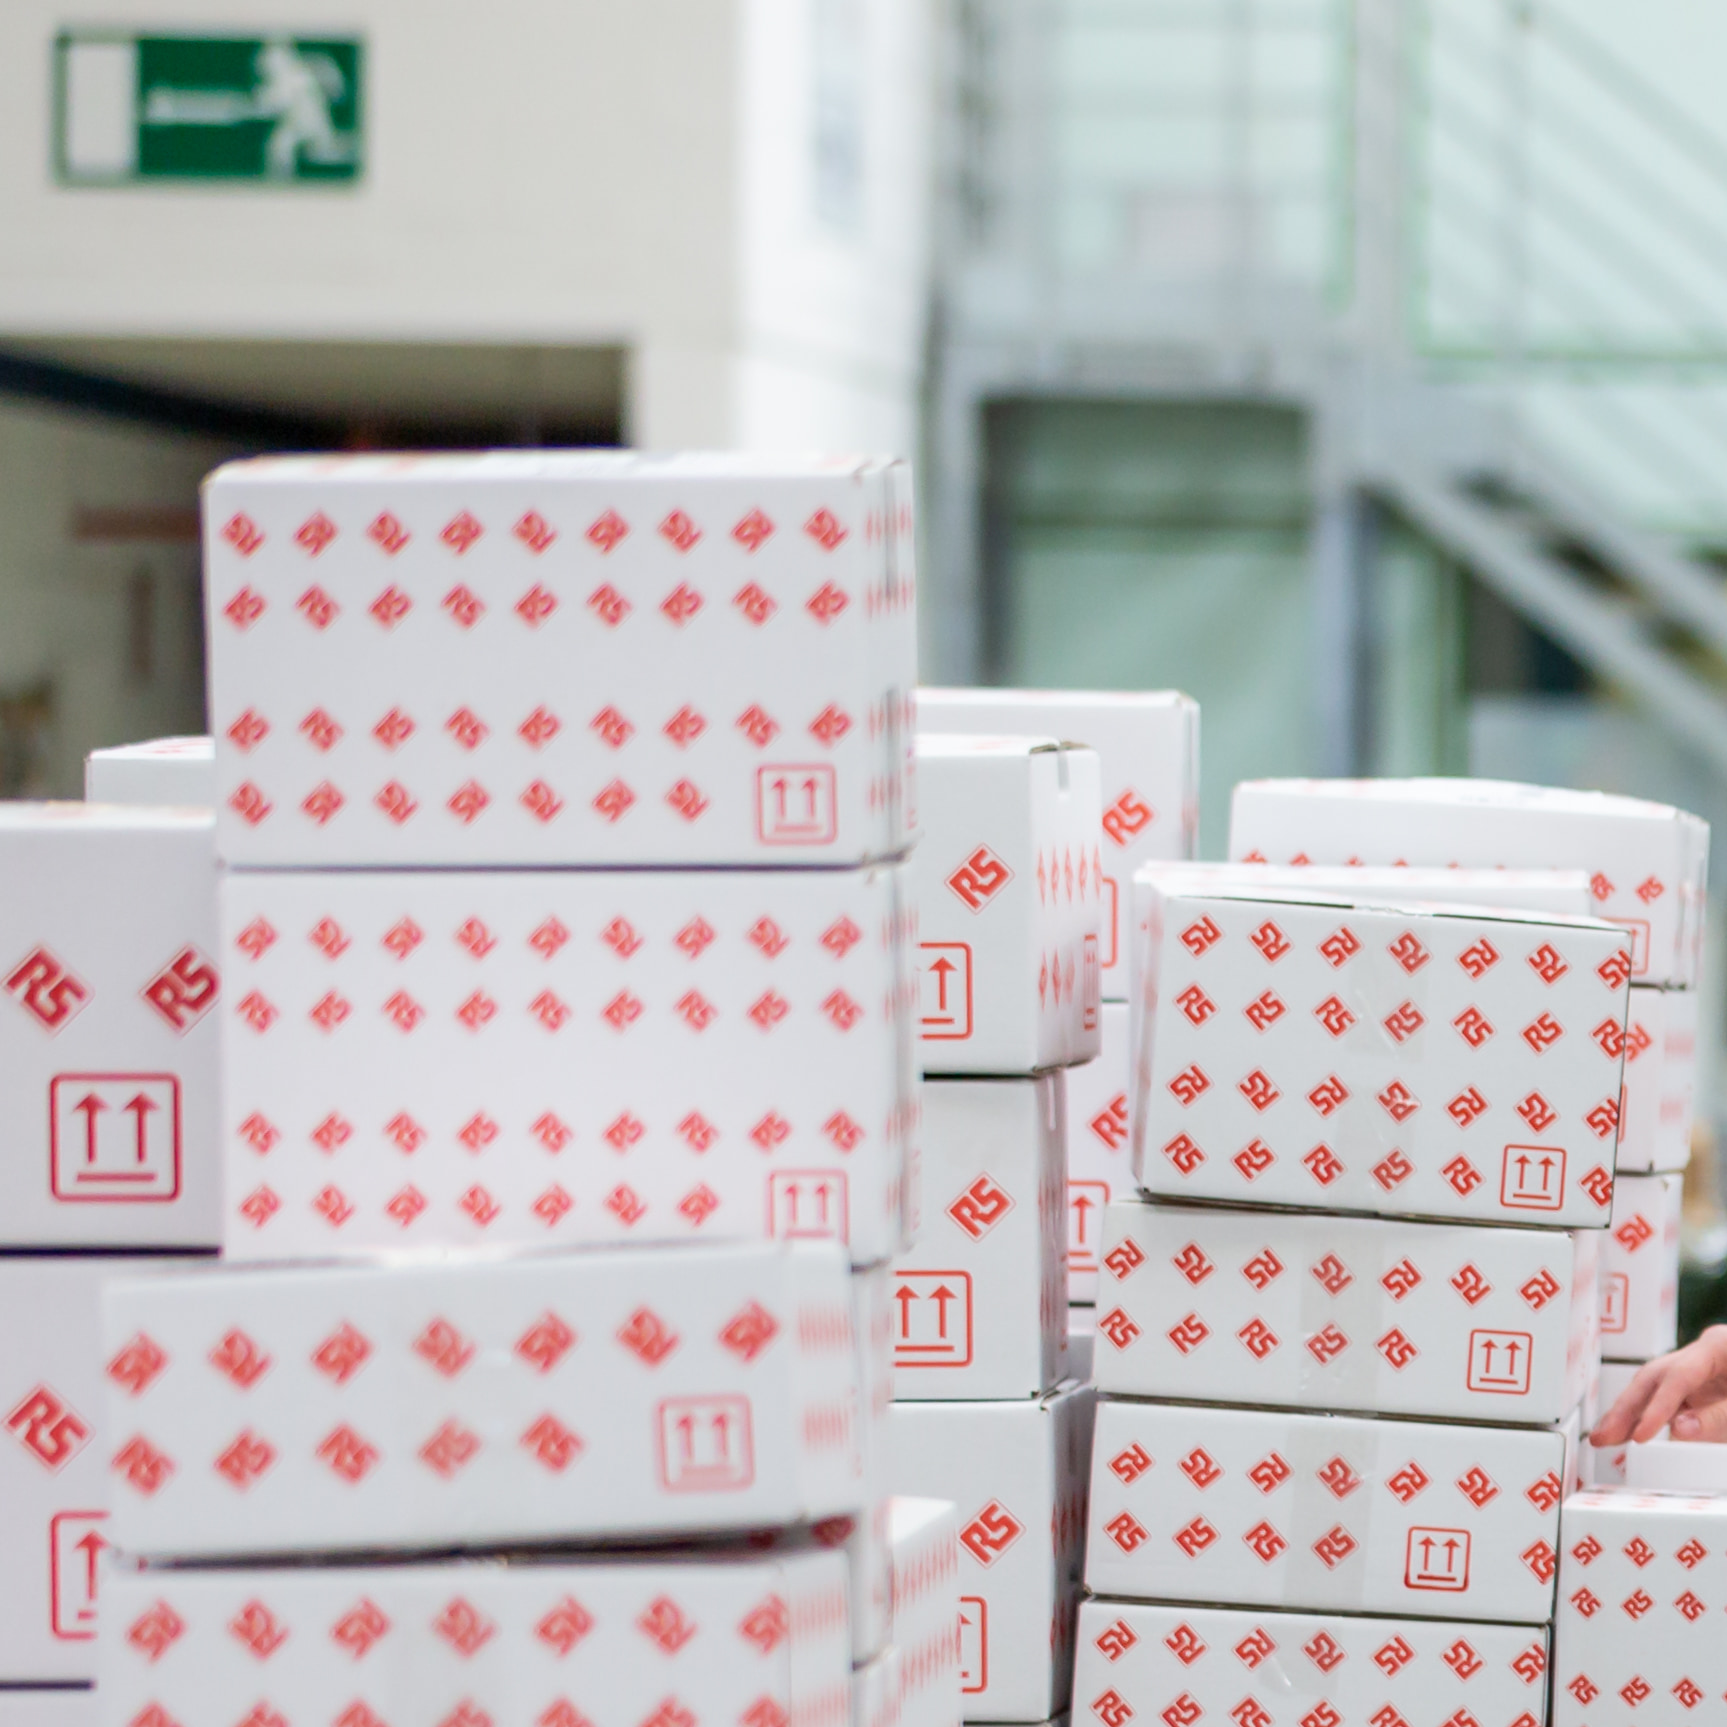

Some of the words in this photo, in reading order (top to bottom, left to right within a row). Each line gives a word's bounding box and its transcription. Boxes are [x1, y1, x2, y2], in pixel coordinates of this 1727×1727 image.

[948, 848, 1009, 909] RS
[1180, 915, 1222, 957] RS
[1250, 921, 1291, 963] RS
[1319, 927, 1361, 968] RS
[1389, 932, 1429, 974] RS
[1458, 938, 1500, 979] RS
[1528, 943, 1569, 985] RS
[6, 949, 86, 1029] RS
[144, 950, 220, 1030] RS
[1175, 984, 1217, 1027] RS
[1244, 990, 1286, 1031] RS
[1314, 995, 1355, 1037] RS
[1384, 1002, 1425, 1042] RS
[1453, 1006, 1494, 1048] RS
[1521, 1012, 1563, 1053] RS
[949, 1177, 1010, 1238] RS
[1613, 1213, 1654, 1253] RS
[1103, 1239, 1145, 1280] RS
[1173, 1243, 1214, 1285] RS
[1242, 1249, 1284, 1290] RS
[1312, 1254, 1352, 1295] RS
[1381, 1259, 1422, 1300] RS
[1450, 1264, 1491, 1306] RS
[1519, 1269, 1561, 1310] RS
[6, 1387, 87, 1468] RS
[1109, 1443, 1153, 1484] RS
[1180, 1447, 1222, 1489] RS
[1248, 1452, 1291, 1494] RS
[1318, 1457, 1359, 1499] RS
[1387, 1461, 1430, 1503] RS
[1457, 1466, 1499, 1508] RS
[959, 1503, 1020, 1564] RS
[1571, 1535, 1603, 1566] RS
[1623, 1536, 1655, 1568] RS
[1675, 1539, 1707, 1570] RS
[1095, 1620, 1137, 1661] RS
[1165, 1624, 1206, 1665] RS
[1234, 1627, 1276, 1669] RS
[1303, 1631, 1345, 1673] RS
[1373, 1635, 1415, 1677] RS
[1442, 1639, 1483, 1680] RS
